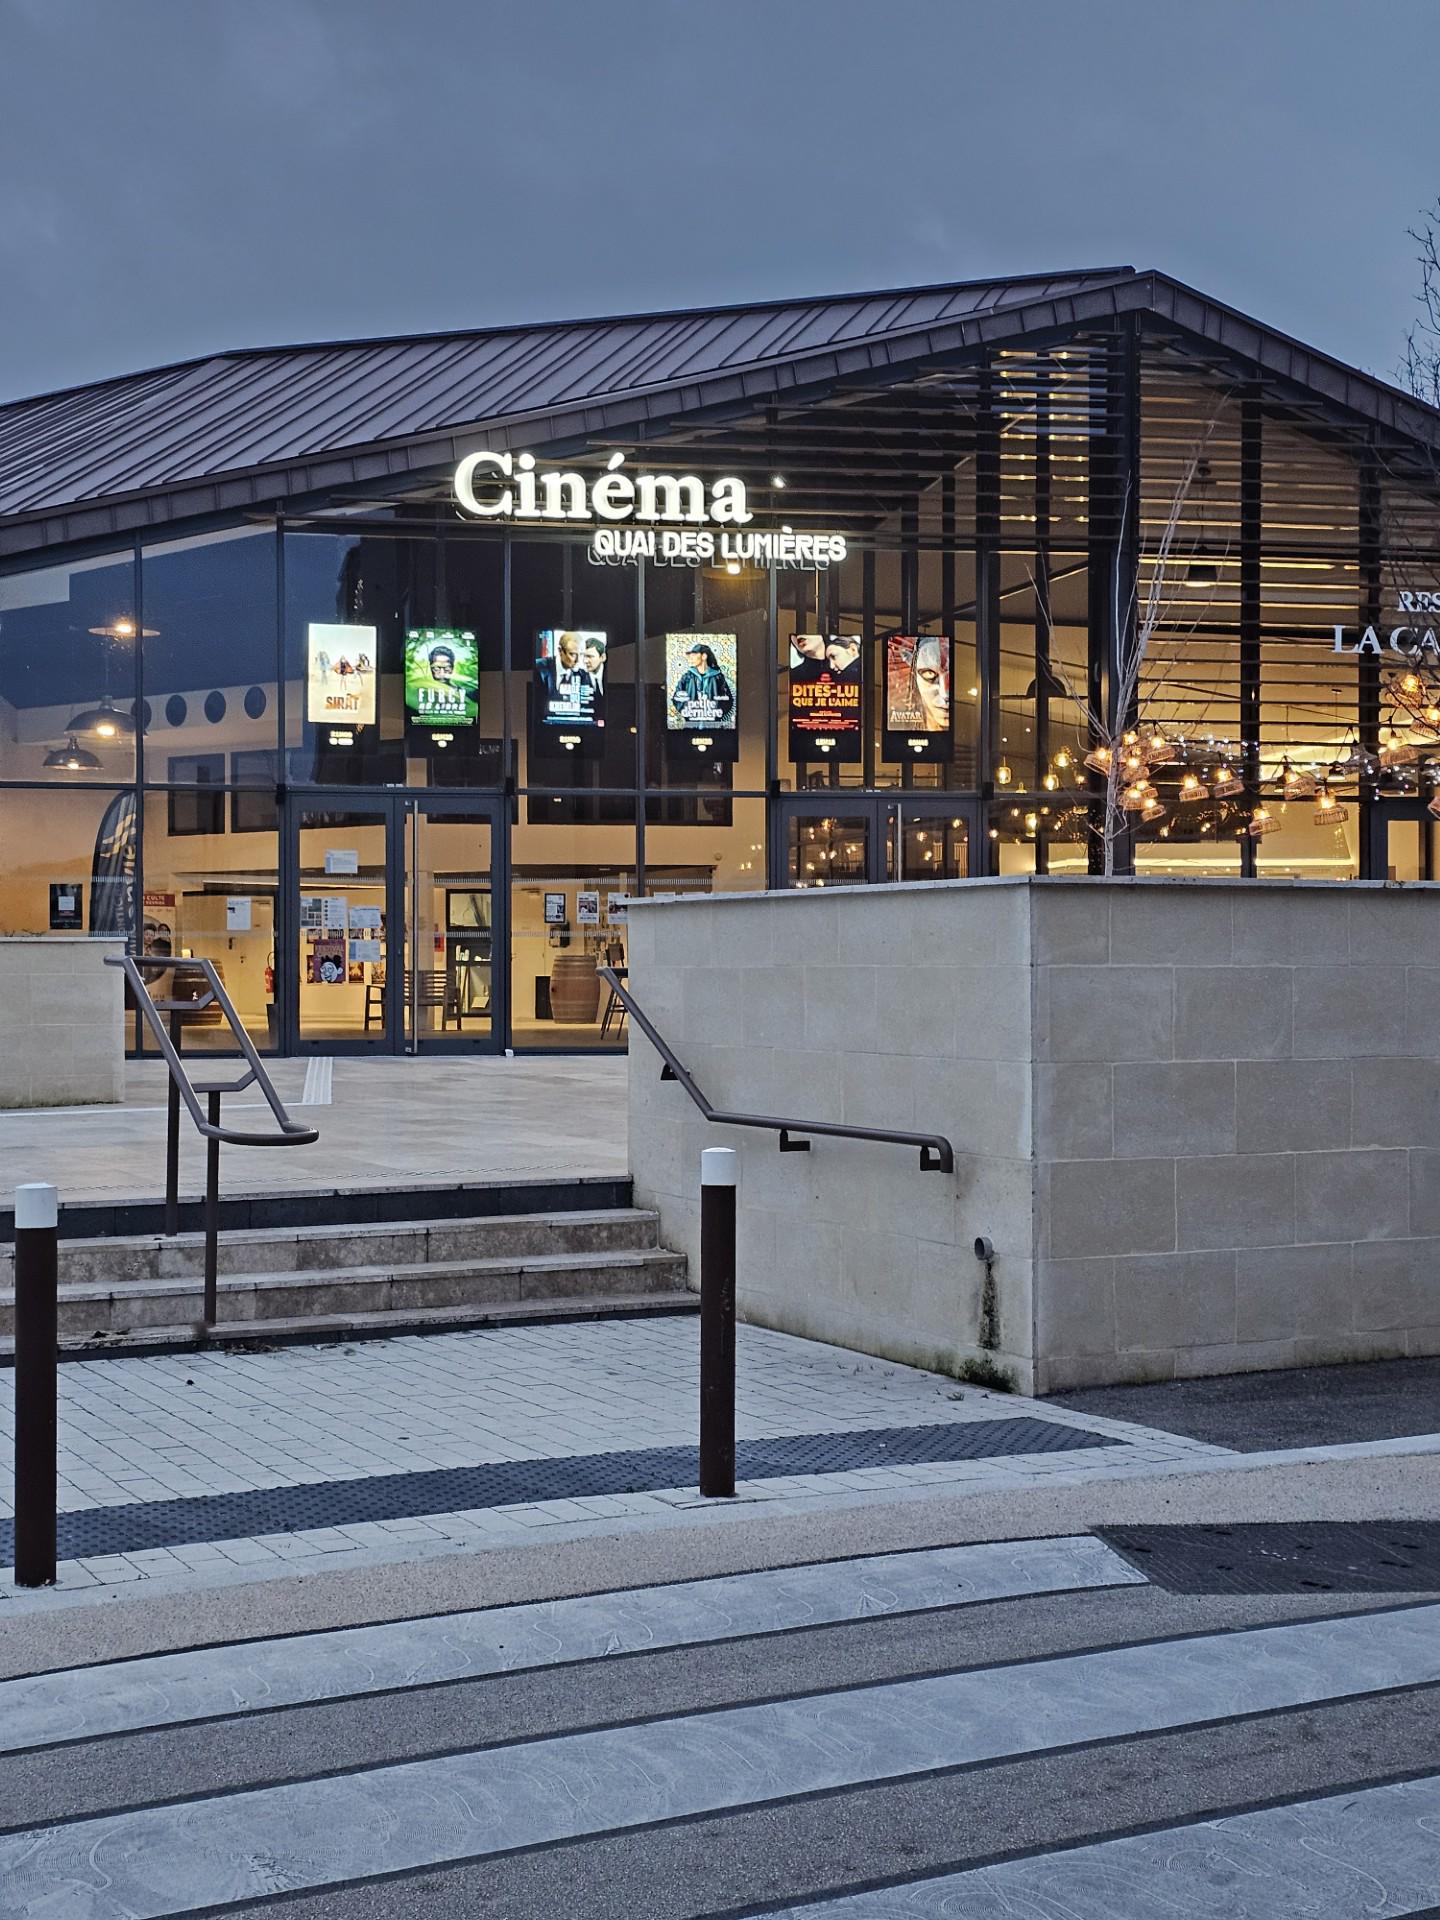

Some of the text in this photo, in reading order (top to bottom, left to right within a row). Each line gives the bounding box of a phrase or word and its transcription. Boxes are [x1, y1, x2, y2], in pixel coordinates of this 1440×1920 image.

[453, 450, 754, 524] Cinéma
[594, 526, 847, 562] QUAI DES LUMIÈRES
[1397, 590, 1440, 613] RES
[1331, 624, 1385, 654] LA
[792, 684, 859, 698] DITES-LUI
[792, 697, 813, 708] QUE
[815, 697, 828, 707] JE
